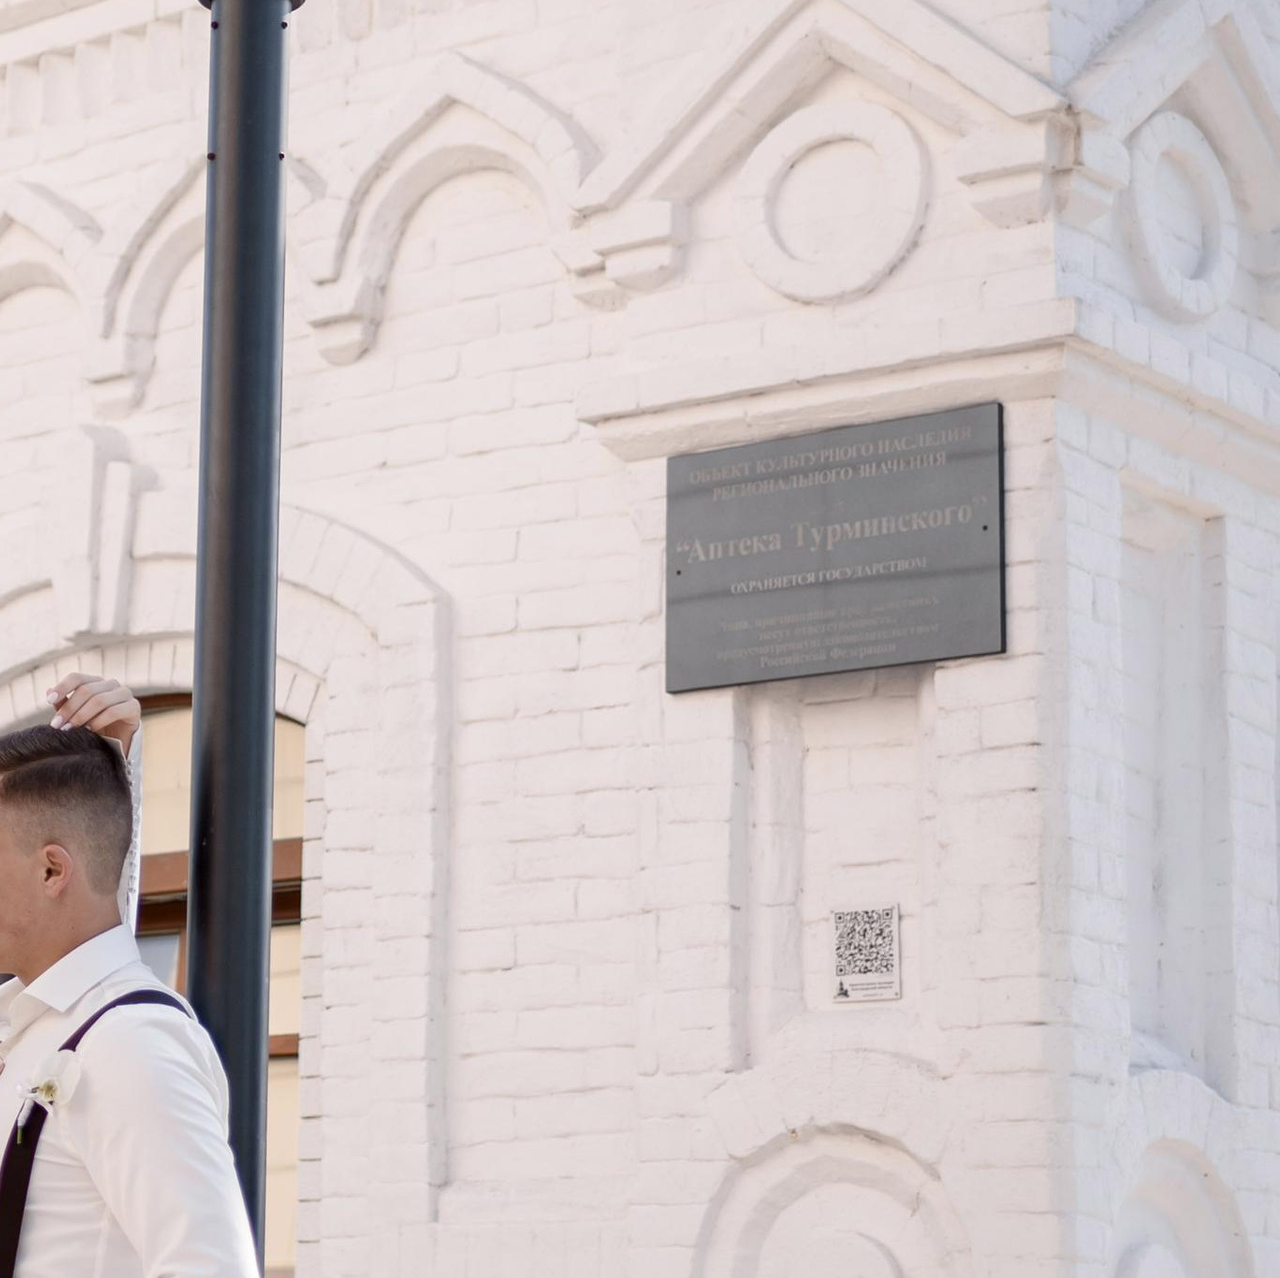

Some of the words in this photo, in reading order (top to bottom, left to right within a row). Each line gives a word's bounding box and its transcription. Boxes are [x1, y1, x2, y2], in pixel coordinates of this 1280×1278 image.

[688, 460, 752, 485] ОБЪЕКТ
[755, 442, 874, 475] КУЛЬТУРНОГО
[877, 425, 973, 455] НАСЛЕДИЯ
[711, 466, 853, 502] РЕГИОНАЛЬНОГО
[858, 449, 948, 479] ЗНАЧЕНИЯ
[730, 571, 816, 595] ОХРАНЯЕТСЯ
[818, 556, 929, 583] ГОСУДАРСТВОМ
